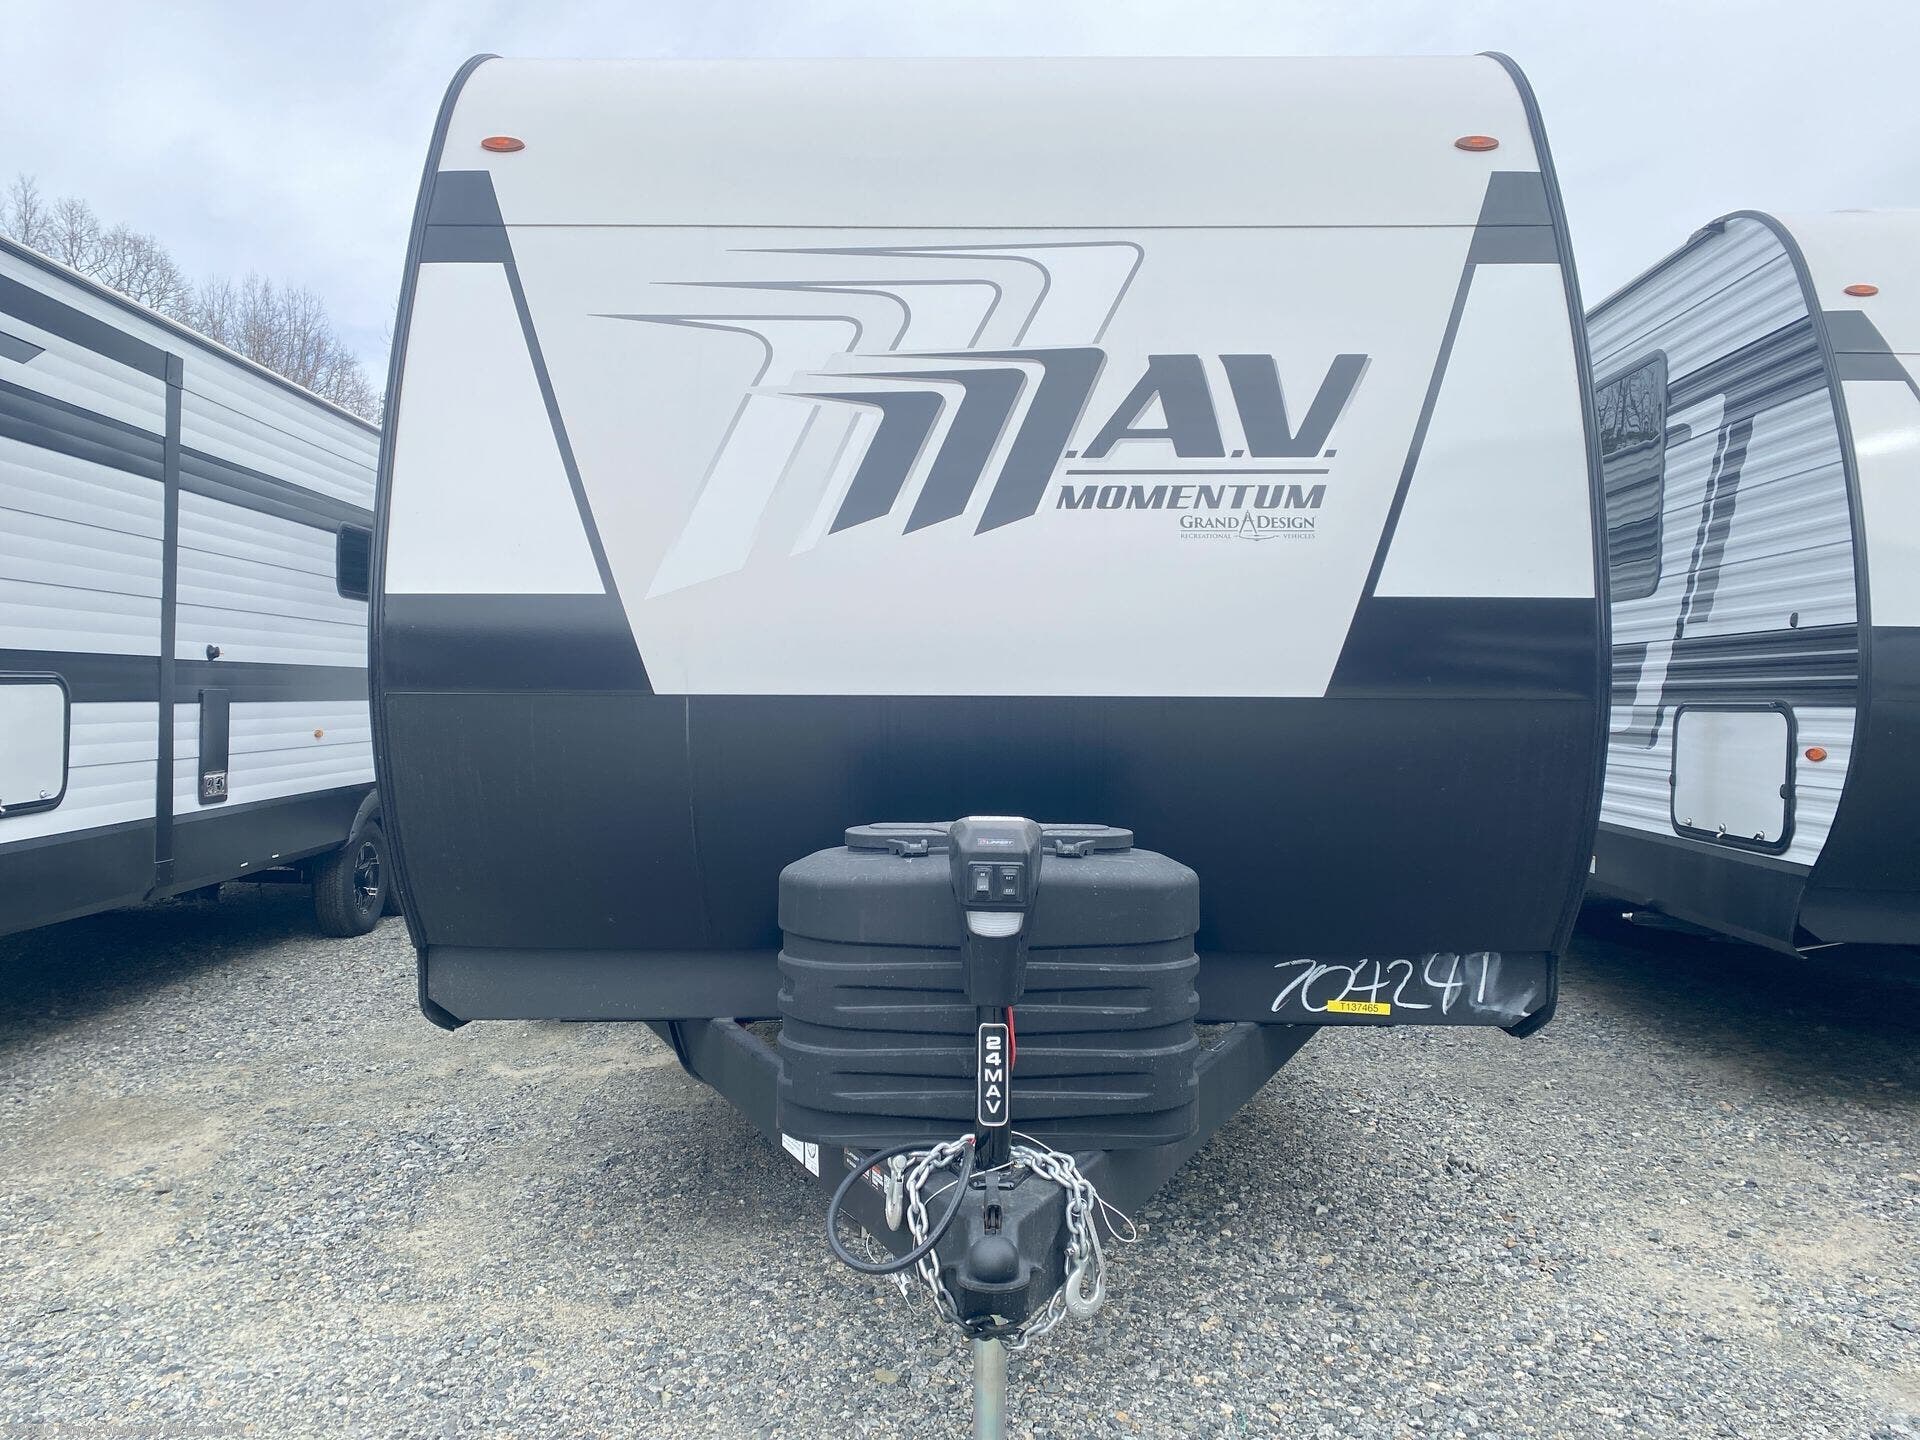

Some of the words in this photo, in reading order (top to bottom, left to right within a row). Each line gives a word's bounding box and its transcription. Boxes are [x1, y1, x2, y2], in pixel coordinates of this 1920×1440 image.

[1056, 485, 1327, 510] MOMENTUM
[1180, 514, 1240, 529] GRAND
[1256, 515, 1316, 529] DESIGN
[1340, 1002, 1379, 1013] T137465
